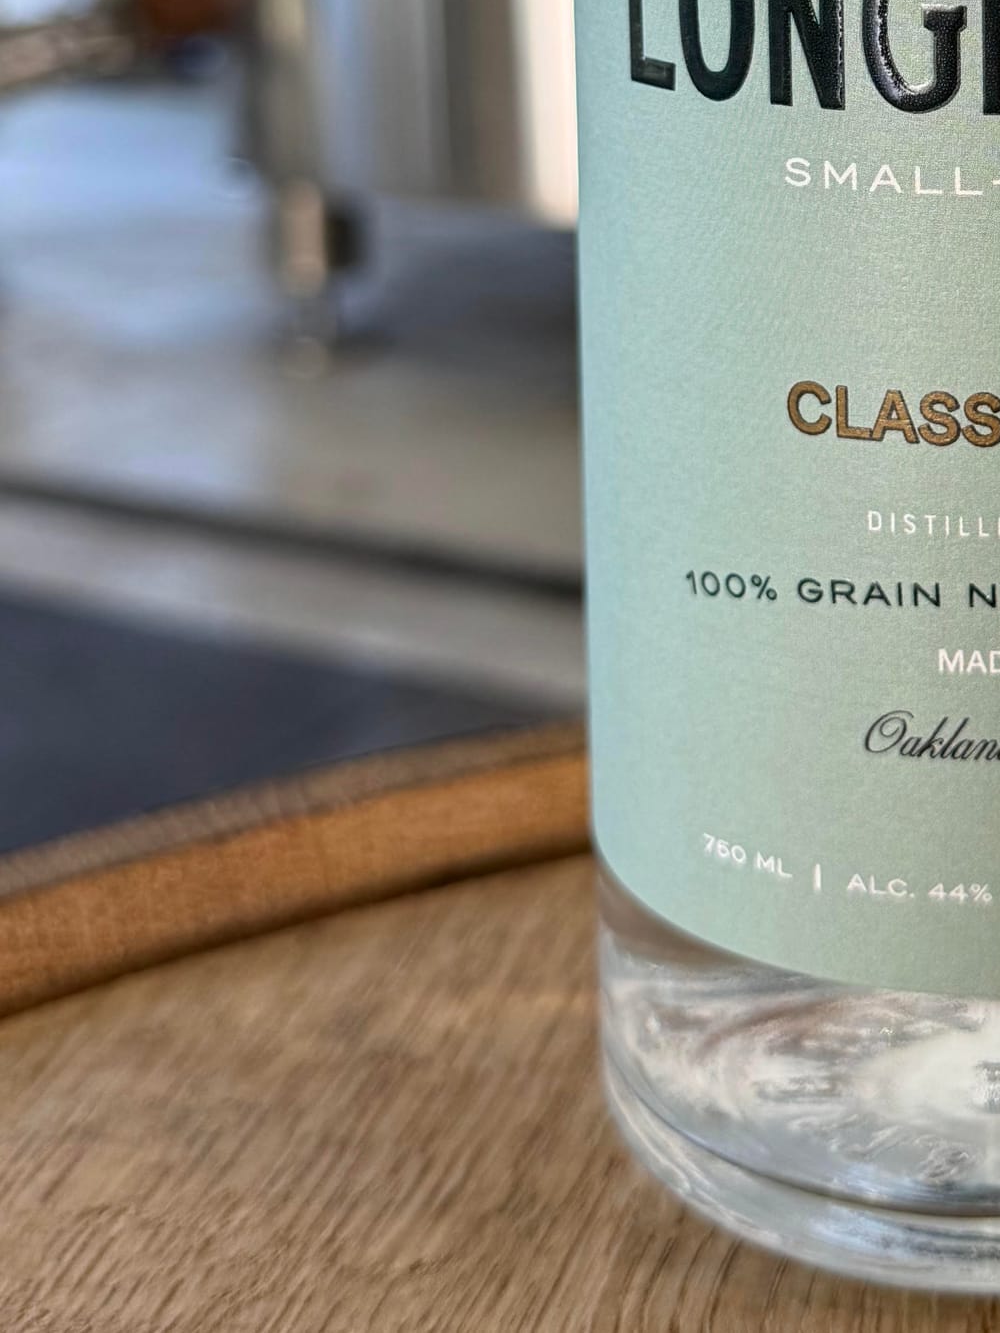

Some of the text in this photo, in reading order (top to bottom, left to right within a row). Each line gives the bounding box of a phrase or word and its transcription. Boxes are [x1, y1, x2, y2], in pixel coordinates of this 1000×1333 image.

[685, 569, 779, 602] 100%
[797, 577, 942, 608] GRAIN
[702, 832, 747, 864] 750
[755, 851, 793, 878] ML
[846, 872, 916, 899] ALC.
[928, 882, 993, 903] 44%
